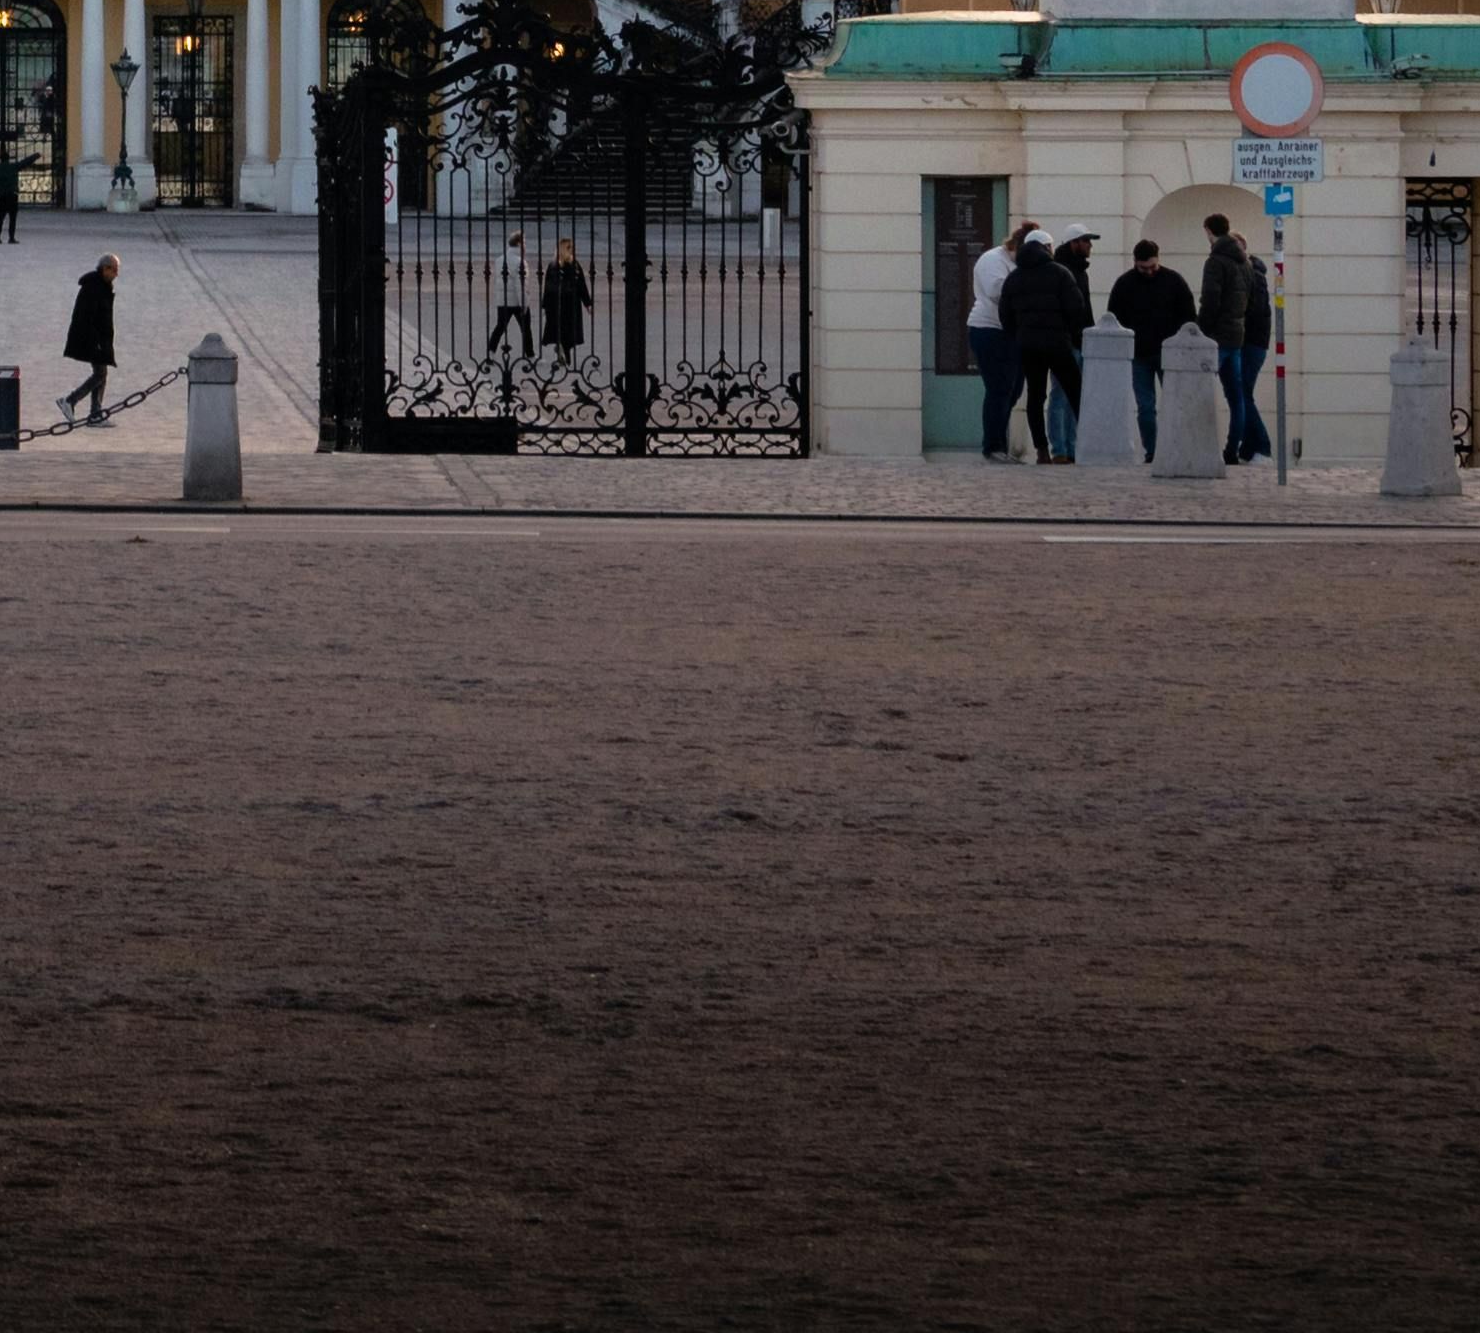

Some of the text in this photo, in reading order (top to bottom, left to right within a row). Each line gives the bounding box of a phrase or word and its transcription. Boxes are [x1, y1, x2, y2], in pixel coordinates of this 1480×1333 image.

[1237, 141, 1319, 153] ausgen. Anrainer
[1240, 155, 1316, 167] und Ausgleichs-
